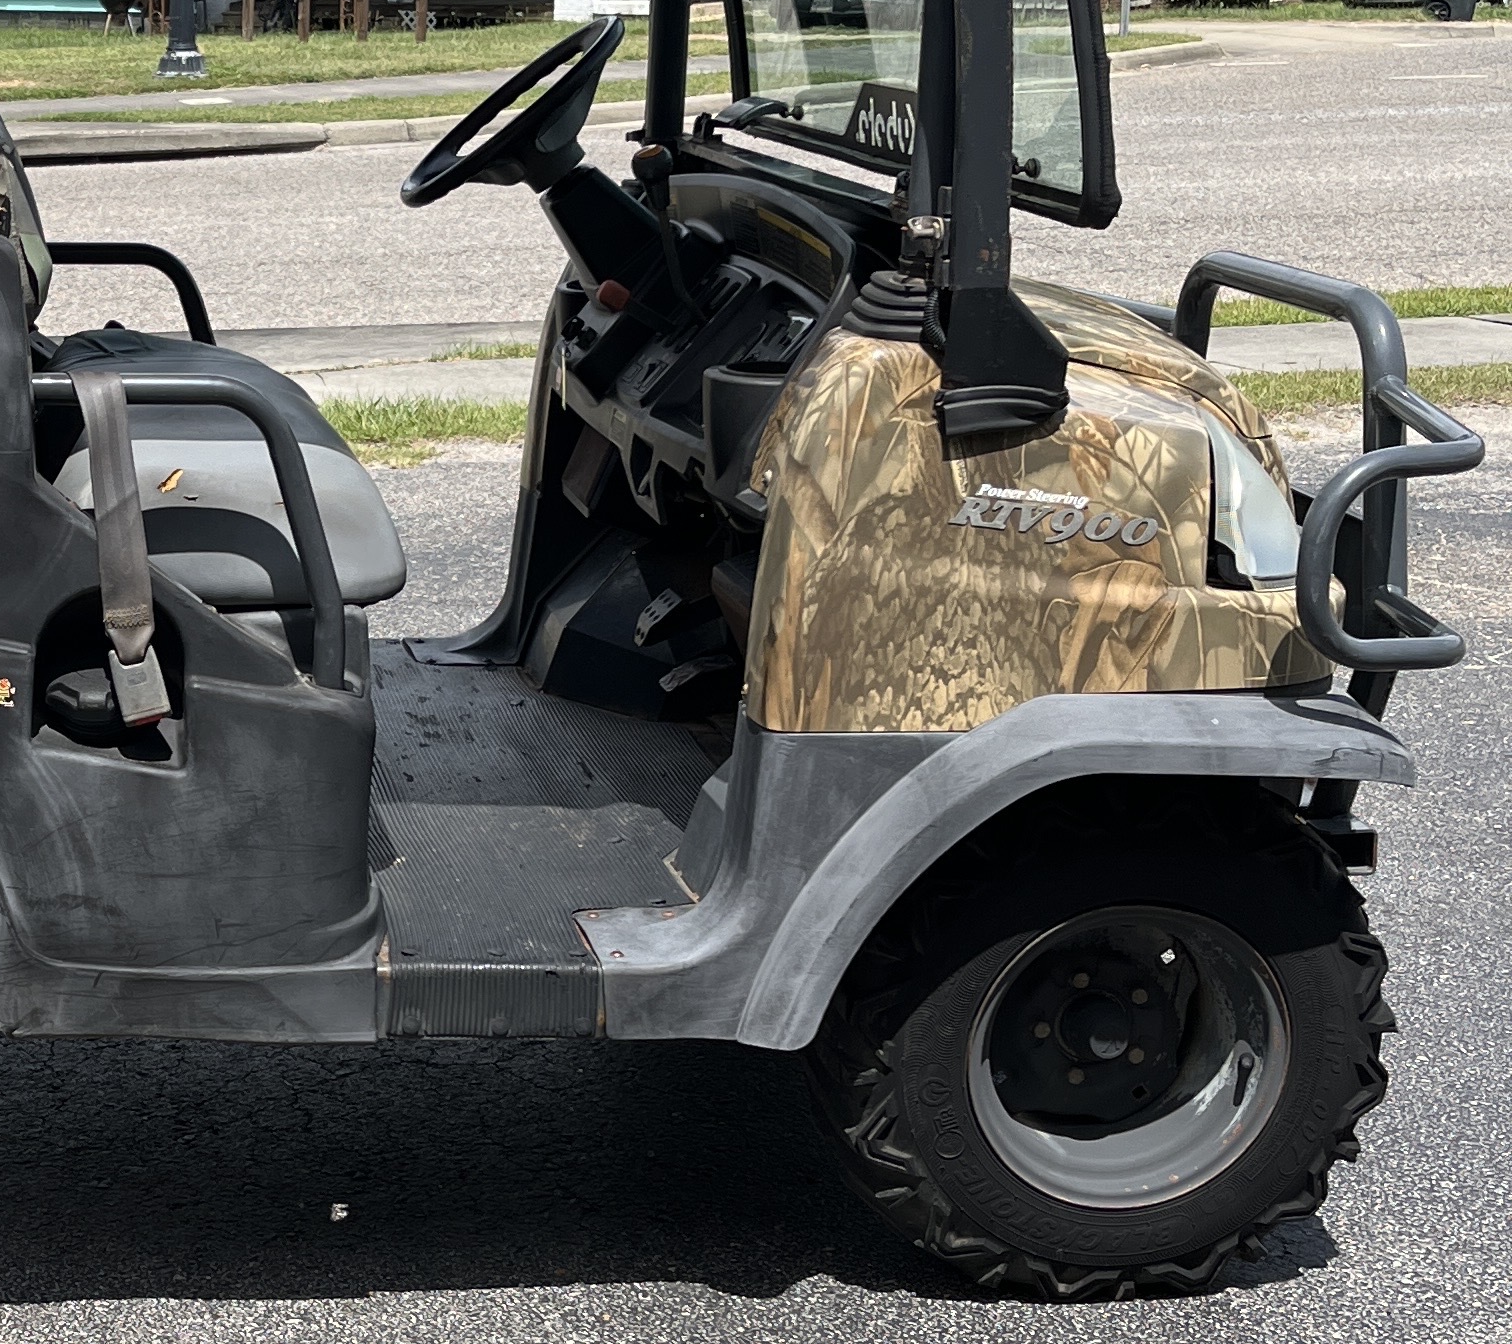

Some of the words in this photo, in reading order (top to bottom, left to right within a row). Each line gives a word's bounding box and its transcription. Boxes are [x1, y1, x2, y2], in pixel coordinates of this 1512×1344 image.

[975, 483, 1027, 502] Power
[1028, 487, 1090, 510] Steering
[948, 496, 1159, 546] RTV900
